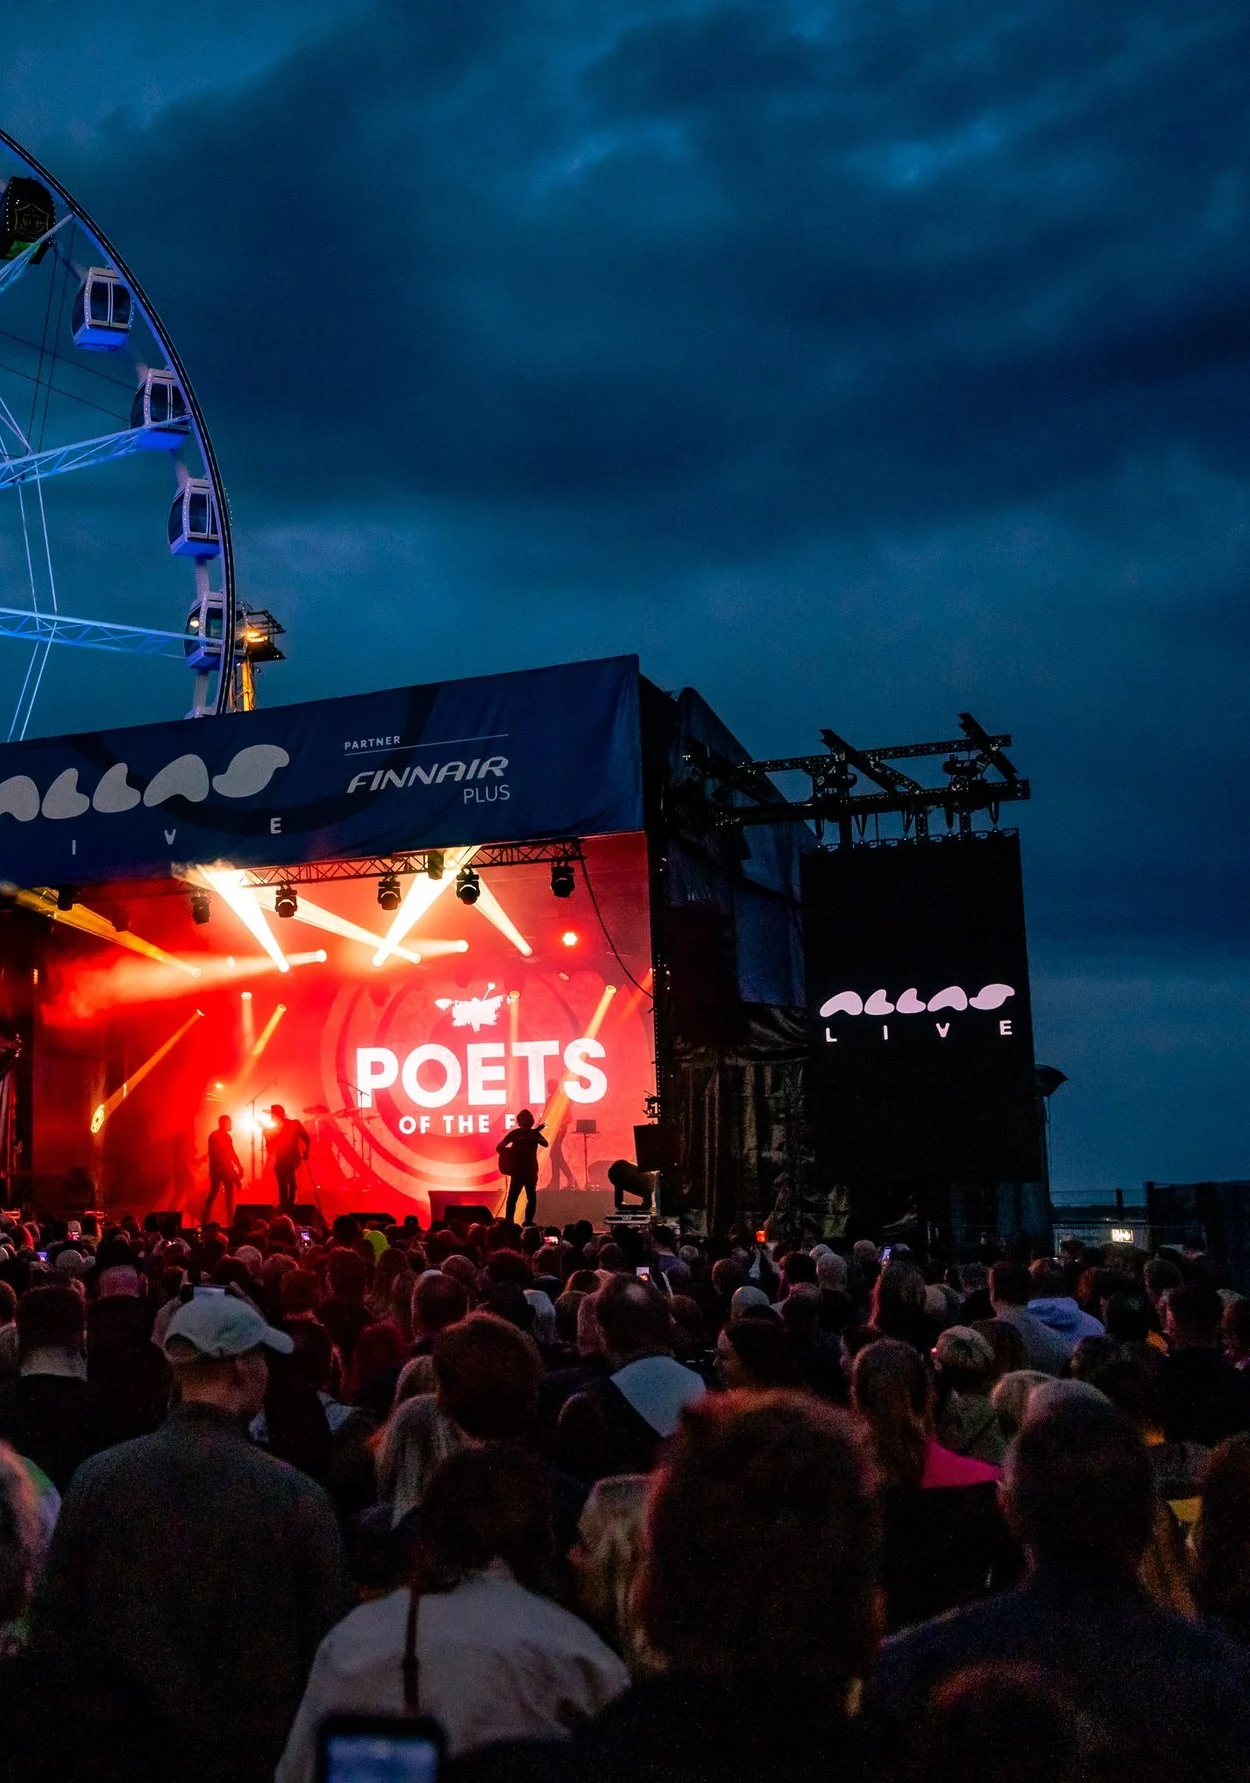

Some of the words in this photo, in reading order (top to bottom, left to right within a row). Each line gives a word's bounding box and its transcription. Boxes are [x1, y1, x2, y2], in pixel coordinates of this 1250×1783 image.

[344, 735, 401, 750] PARTNER
[346, 756, 509, 794] FINNAIR
[463, 784, 511, 804] PLUS
[819, 983, 1016, 1018] ALLAS
[356, 1036, 608, 1109] POETS
[398, 1115, 431, 1135] OF
[442, 1114, 490, 1134] THE
